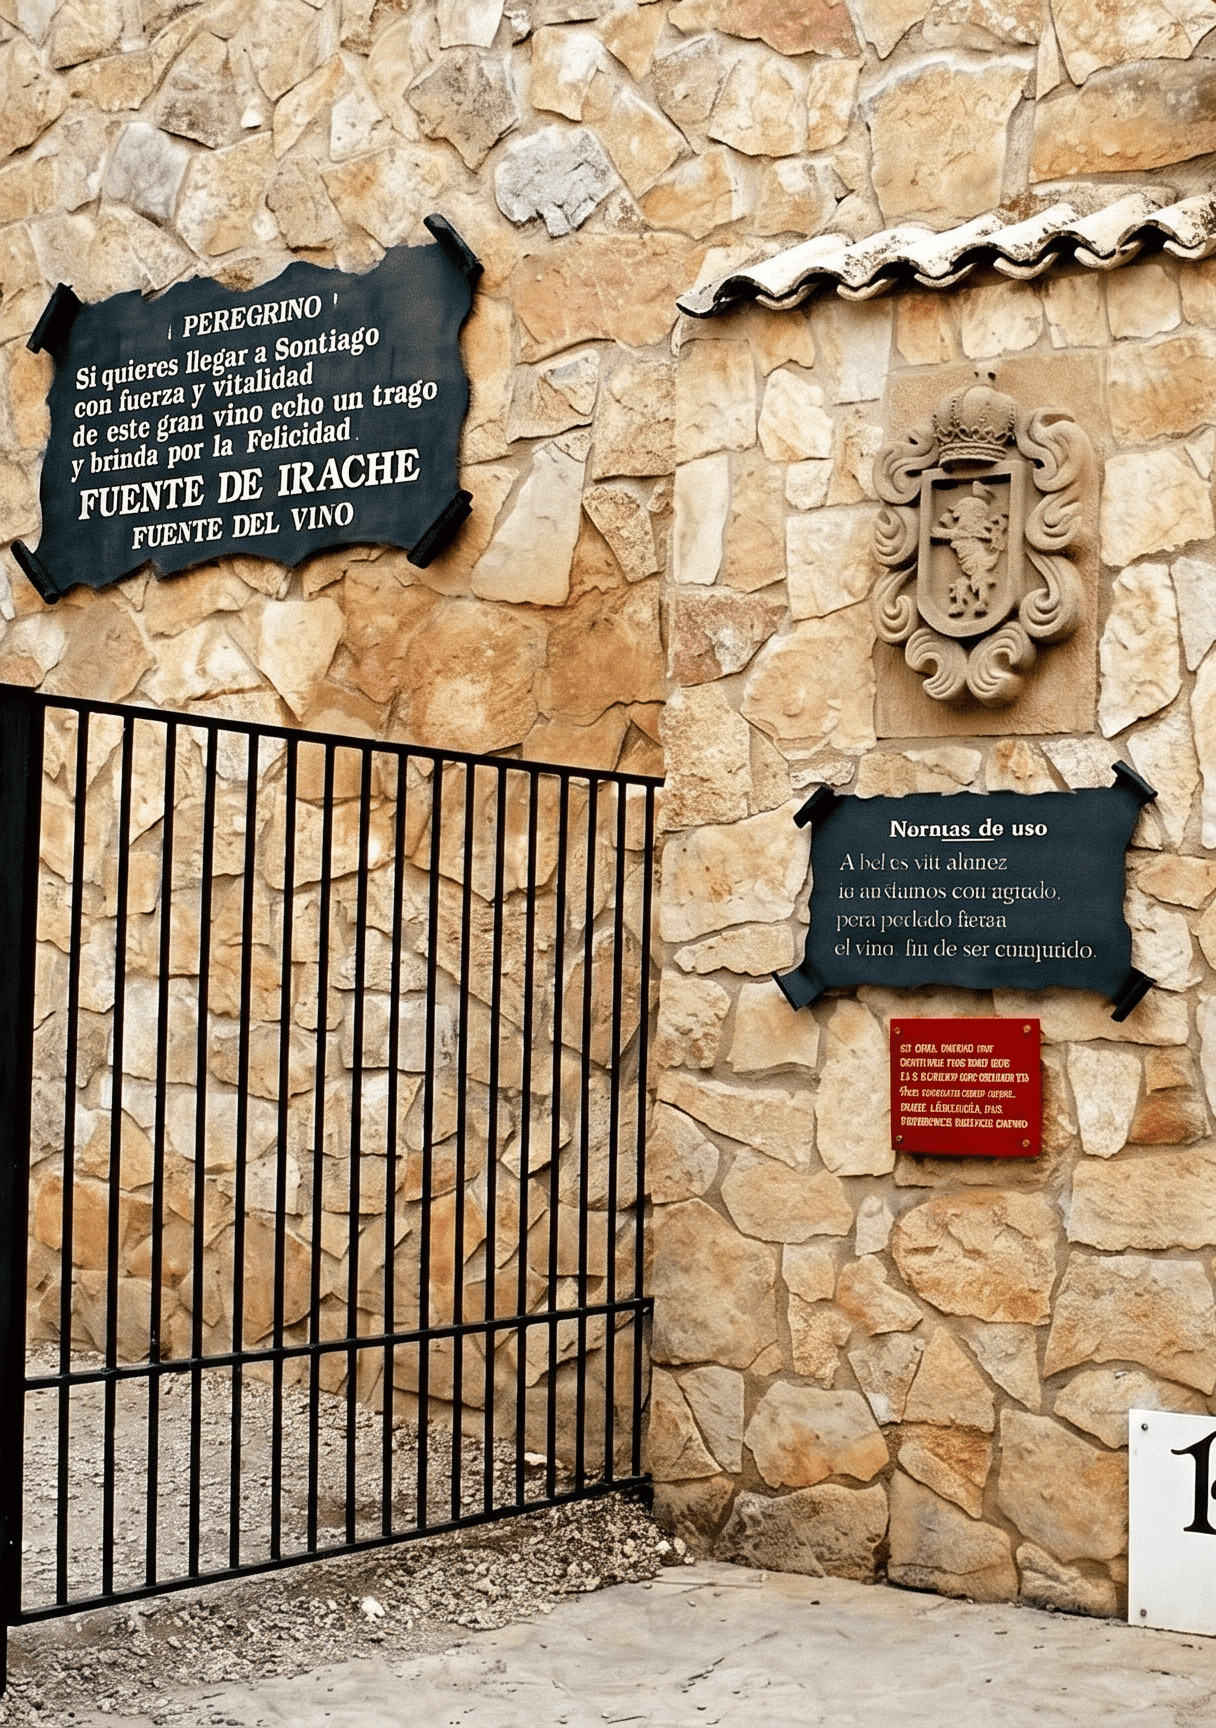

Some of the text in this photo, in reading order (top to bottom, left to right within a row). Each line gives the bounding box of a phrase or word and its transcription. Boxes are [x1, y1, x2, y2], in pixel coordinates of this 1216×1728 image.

[182, 295, 322, 338] PEREGRINO
[74, 361, 313, 419] con fuerza y vitalidad
[75, 365, 97, 390] Si
[101, 358, 179, 392] quieres
[185, 348, 249, 377] llegar
[254, 345, 267, 363] a
[72, 379, 438, 448] de este gran vino echo un trago
[70, 458, 85, 484] y
[90, 443, 158, 474] brinda
[167, 442, 204, 469] por
[212, 433, 233, 457] la
[78, 448, 421, 521] FUENTE DE IRACHE
[131, 501, 355, 550] FUENTE DEL VINO
[978, 817, 1005, 837] de
[1010, 822, 1050, 837] uso
[839, 852, 855, 871] A
[834, 937, 851, 957] el
[933, 937, 958, 957] de
[962, 943, 991, 957] ser
